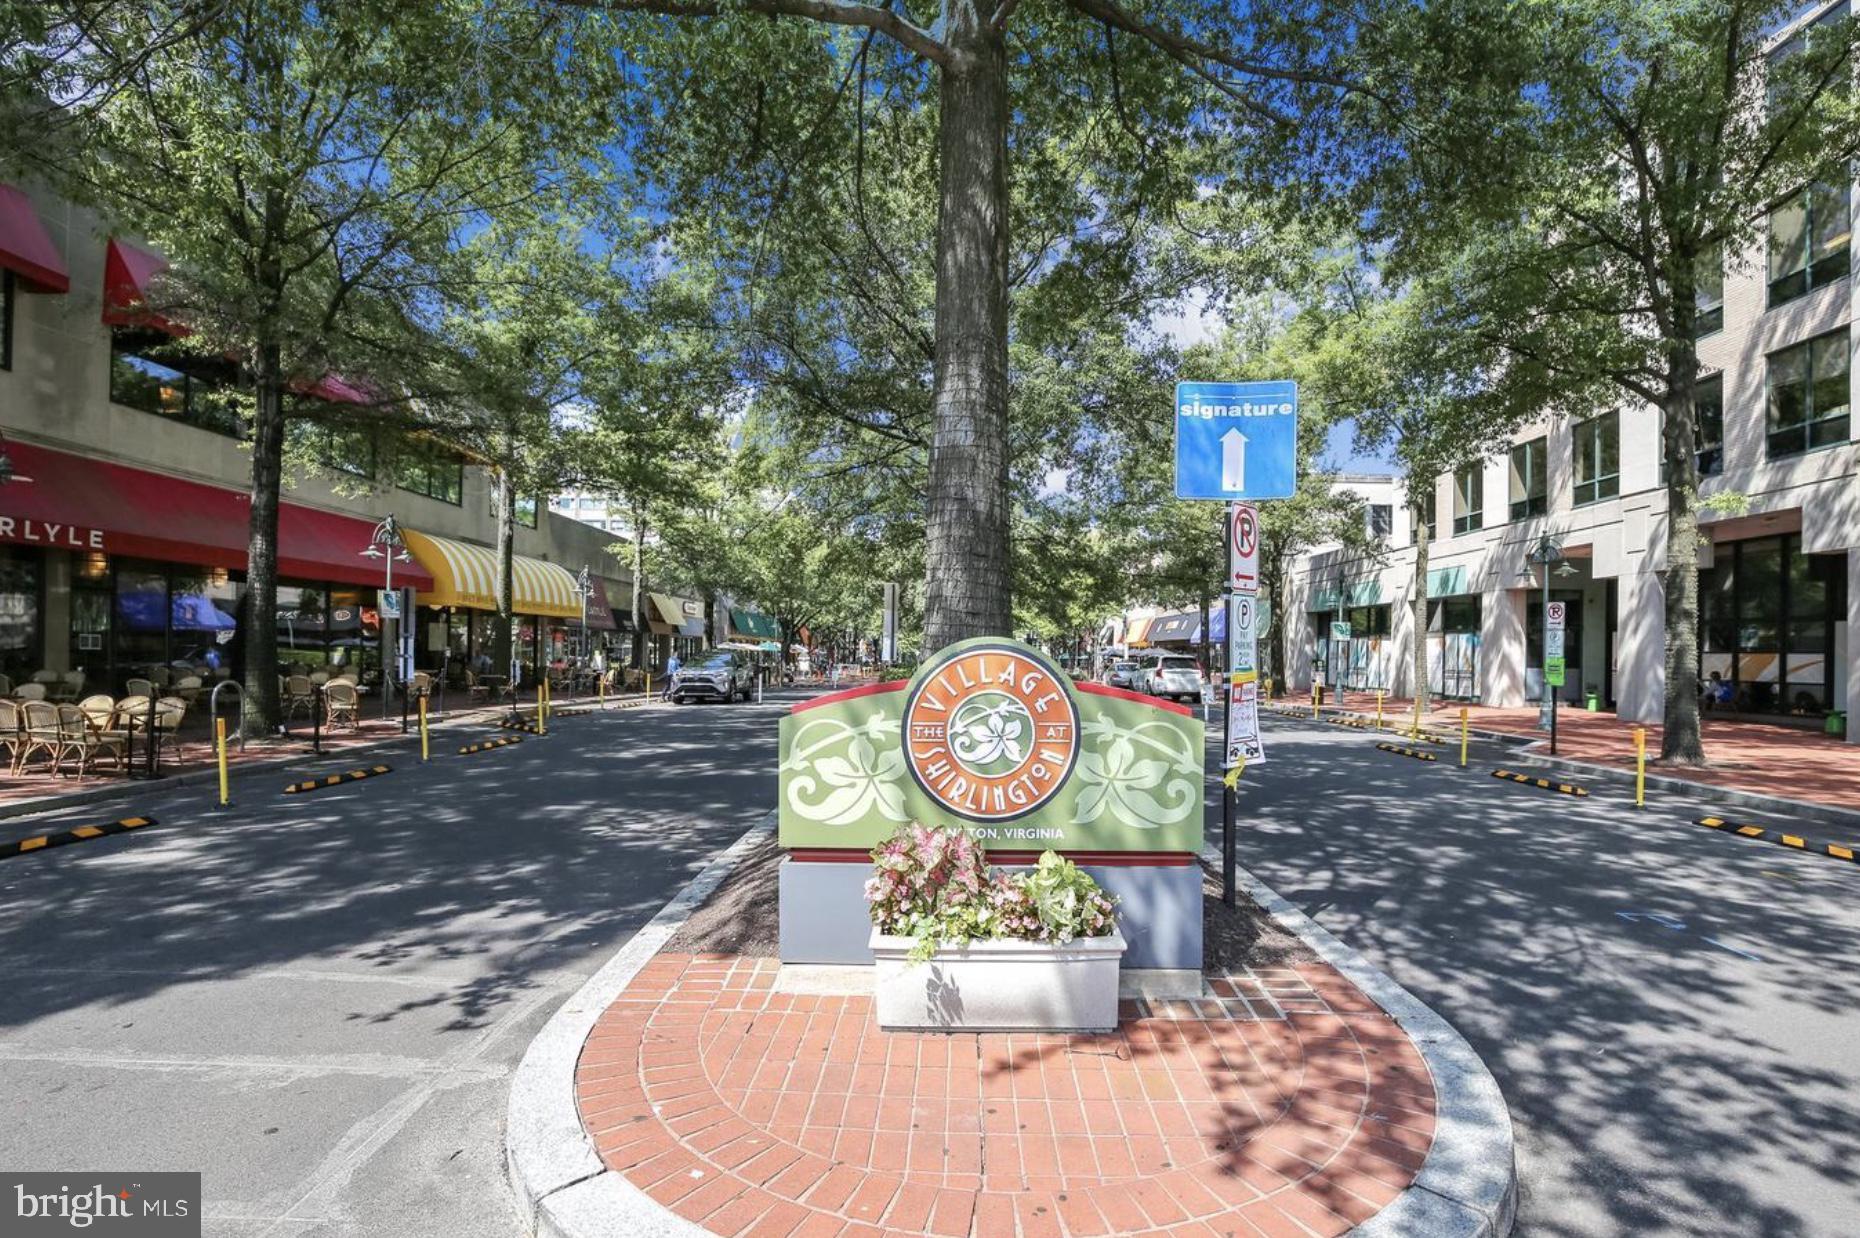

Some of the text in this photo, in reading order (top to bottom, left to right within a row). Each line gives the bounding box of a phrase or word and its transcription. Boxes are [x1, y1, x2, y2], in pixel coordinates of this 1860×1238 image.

[1180, 395, 1293, 419] signature
[0, 516, 104, 548] RLYLE
[920, 656, 1060, 713] VILLAGE
[914, 726, 945, 738] THE
[1046, 726, 1068, 737] AT
[915, 746, 1065, 811] SHIRLINGTON
[1004, 828, 1065, 839] VIRGINIA
